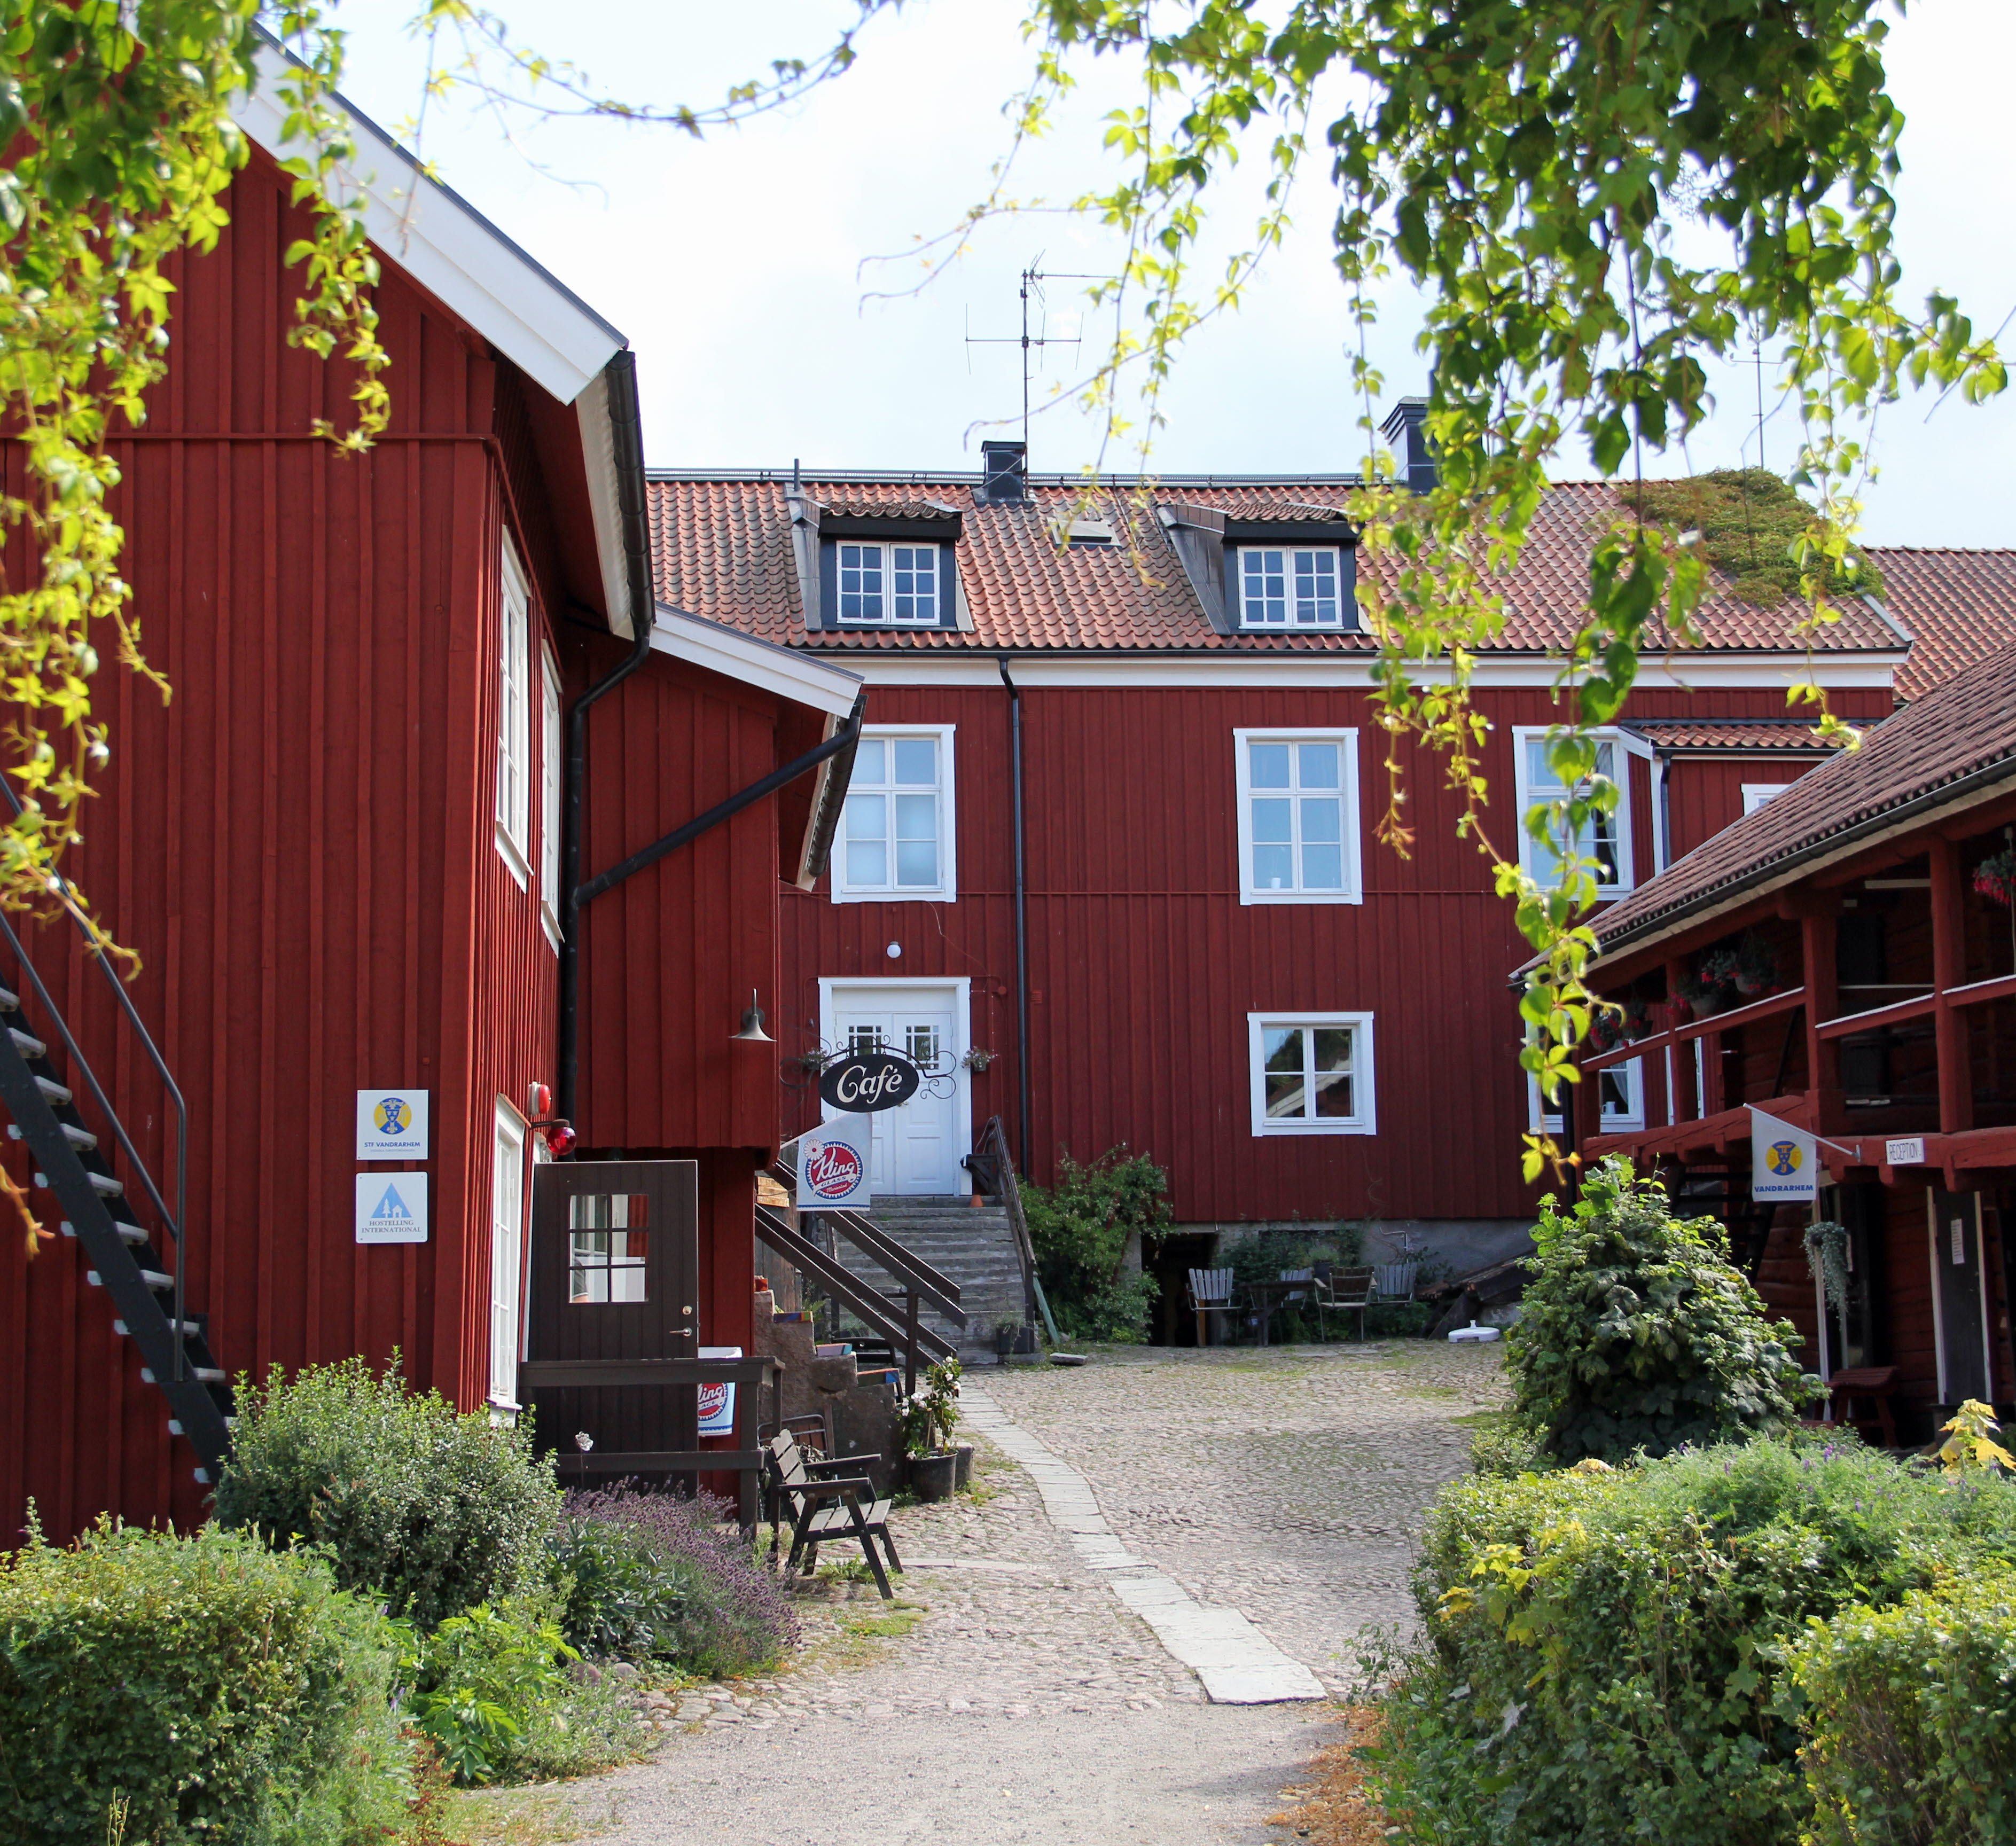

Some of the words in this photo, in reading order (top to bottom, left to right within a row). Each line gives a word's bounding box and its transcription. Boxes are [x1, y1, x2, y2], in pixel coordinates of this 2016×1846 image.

[837, 1065, 903, 1104] Café
[812, 1147, 855, 1182] Kling
[821, 1176, 847, 1187] GLASS
[698, 1383, 723, 1403] ling
